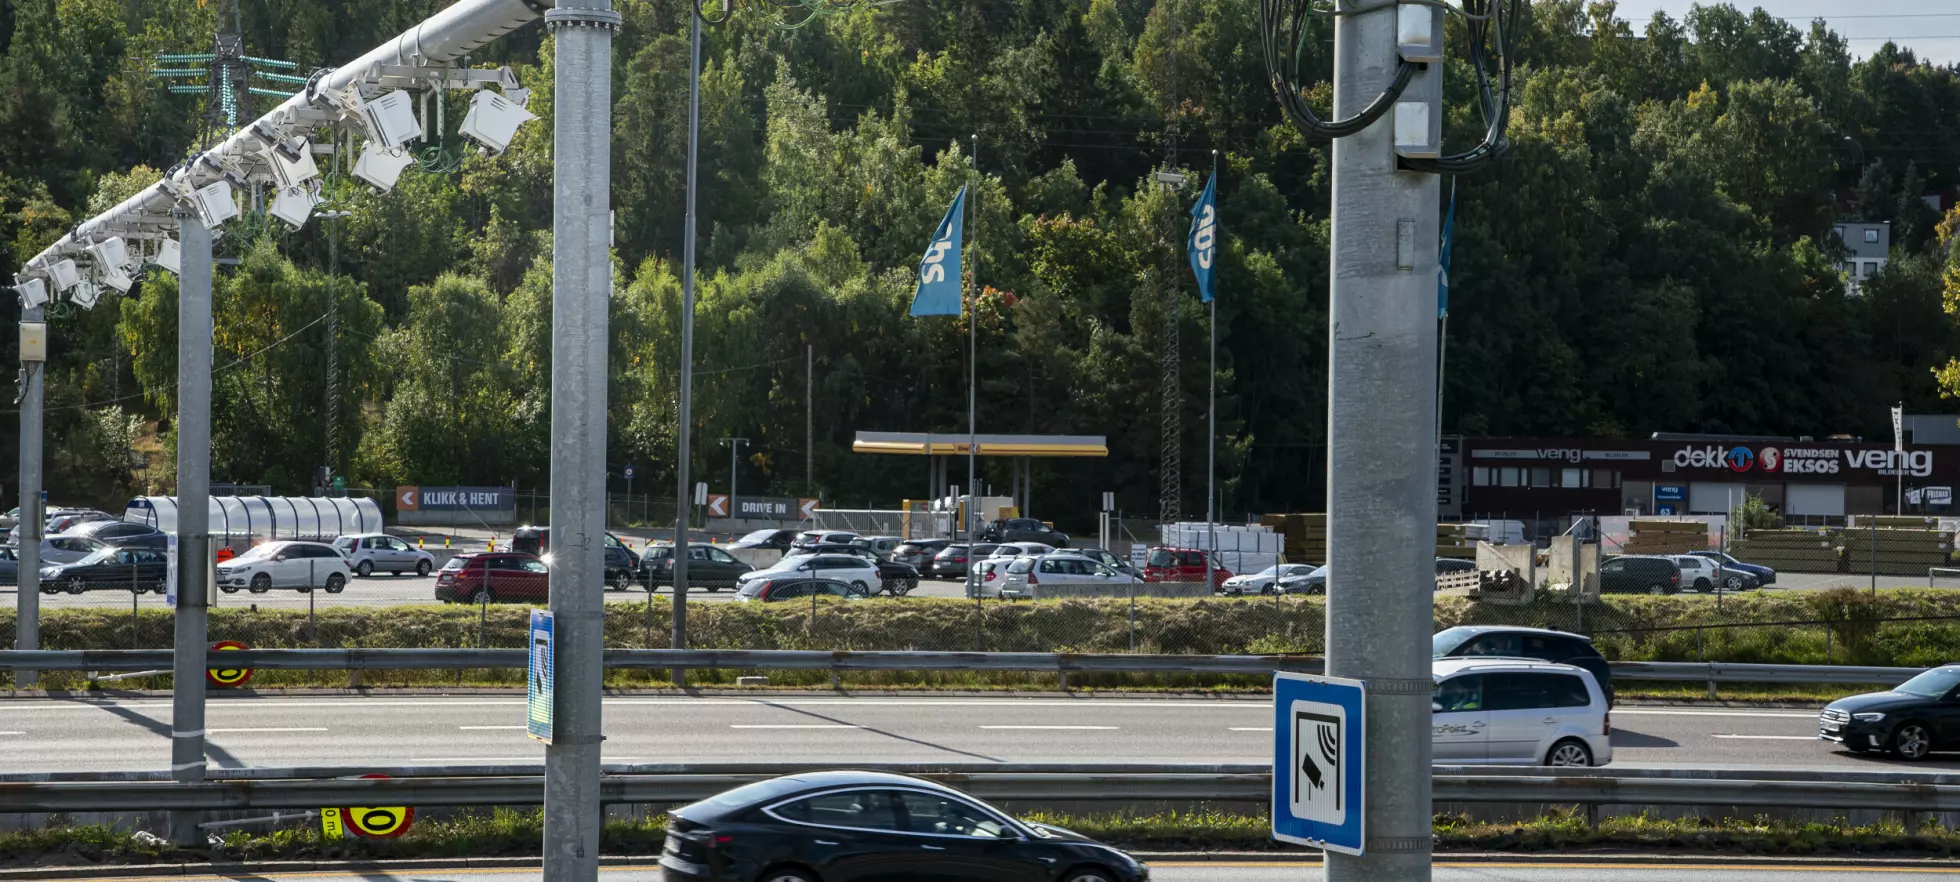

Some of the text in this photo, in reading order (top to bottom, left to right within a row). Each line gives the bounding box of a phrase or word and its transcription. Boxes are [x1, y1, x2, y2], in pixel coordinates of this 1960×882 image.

[1537, 449, 1581, 463] veng
[1784, 449, 1839, 458] SVENDSEN
[1783, 459, 1840, 474] EKSOS
[1845, 449, 1933, 477] veng
[423, 491, 499, 505] KLIKK & HENT
[742, 502, 786, 514] DRIVE IN
[1660, 508, 1671, 516] 63
